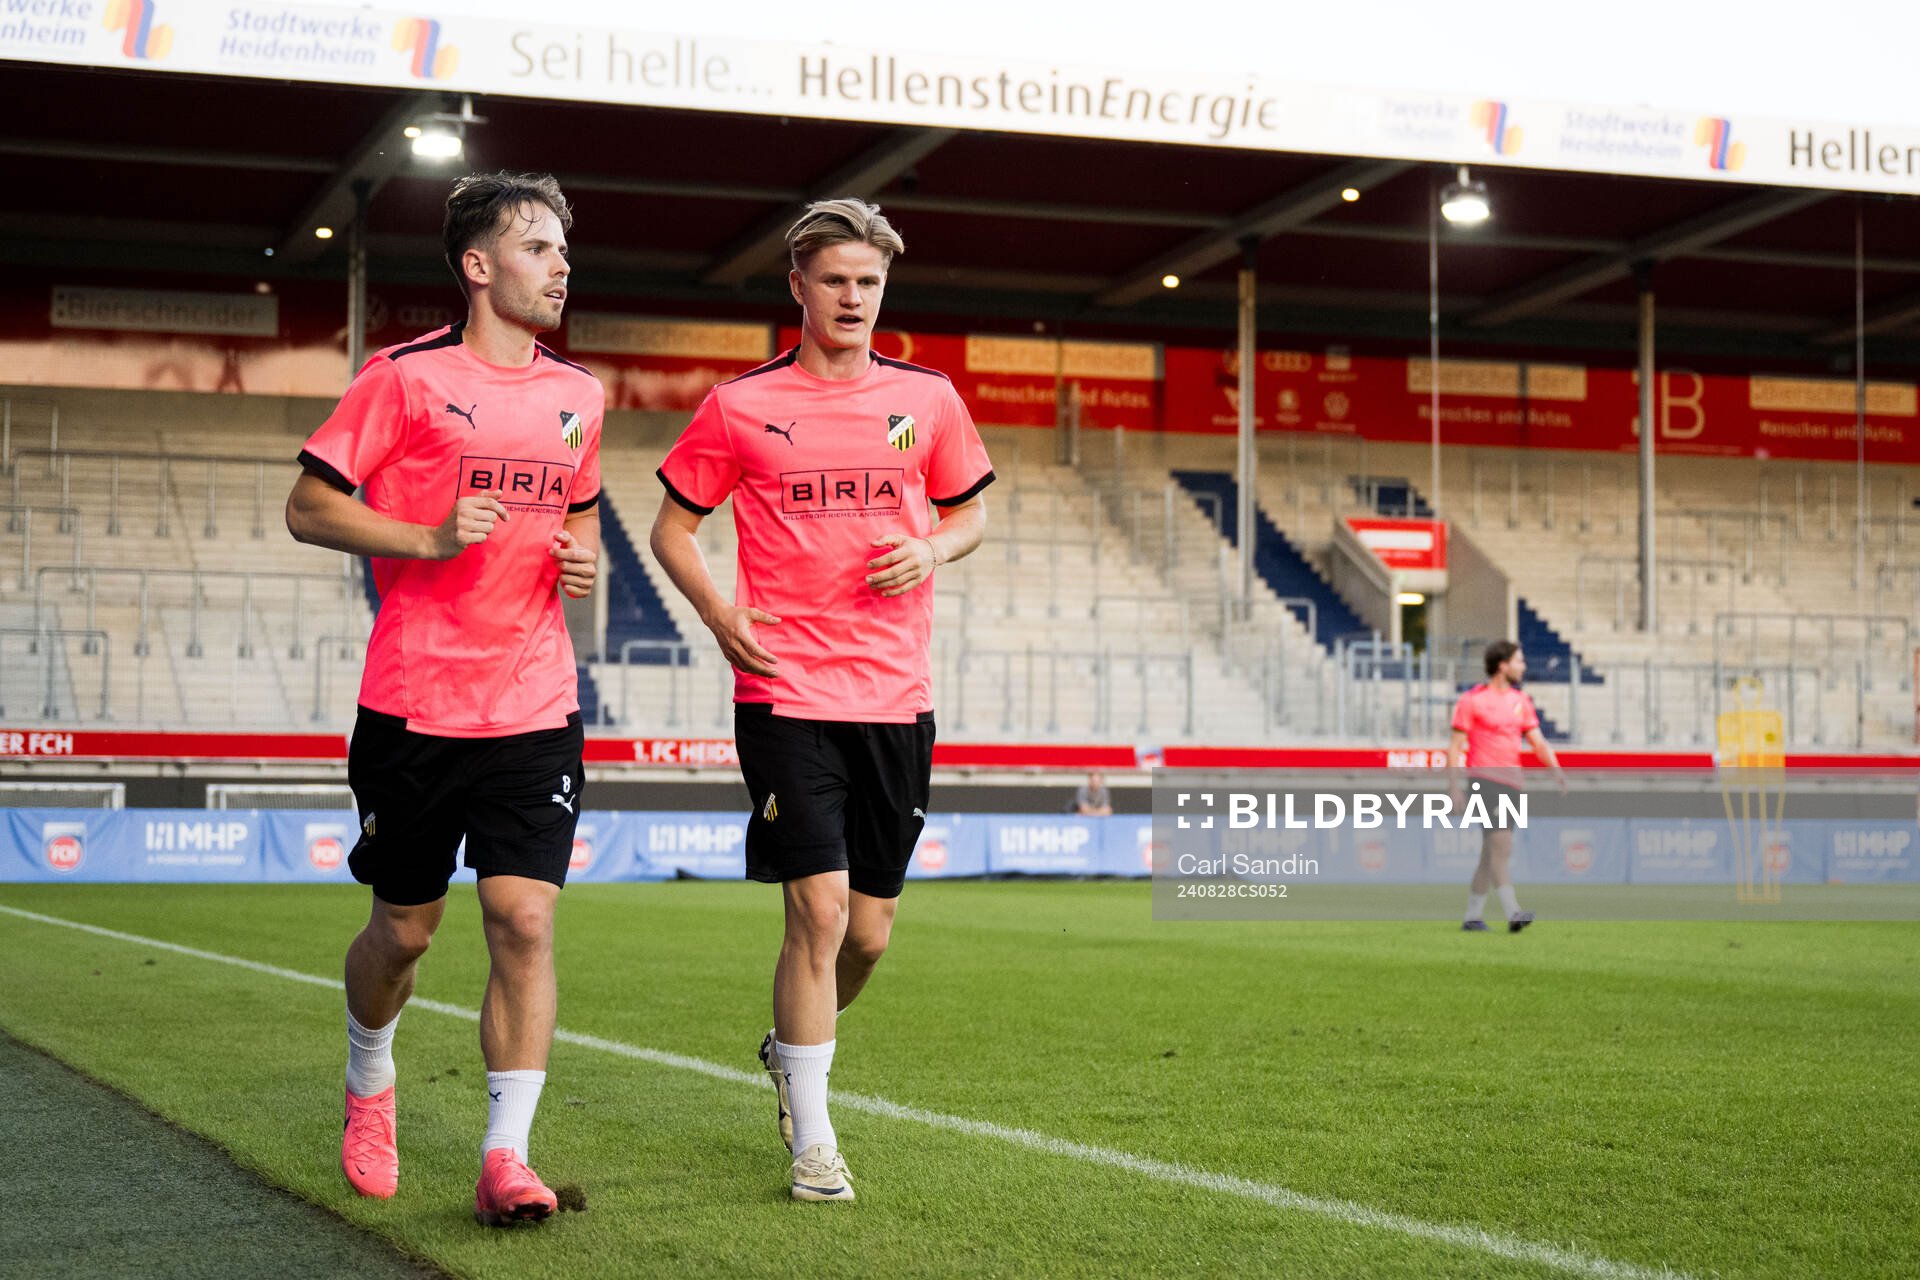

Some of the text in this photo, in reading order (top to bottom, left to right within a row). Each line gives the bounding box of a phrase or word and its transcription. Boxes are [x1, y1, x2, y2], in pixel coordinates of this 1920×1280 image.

[228, 9, 384, 40] Stadtwerke
[219, 36, 378, 66] Heidenheim
[510, 31, 584, 81] Sei
[799, 54, 1280, 139] HellensteinEnergie
[29, 732, 74, 754] FCH
[652, 741, 679, 763] FC
[561, 774, 571, 793] 8
[179, 822, 248, 850] MHP
[678, 824, 743, 851] MHP
[1029, 827, 1090, 853] MHP
